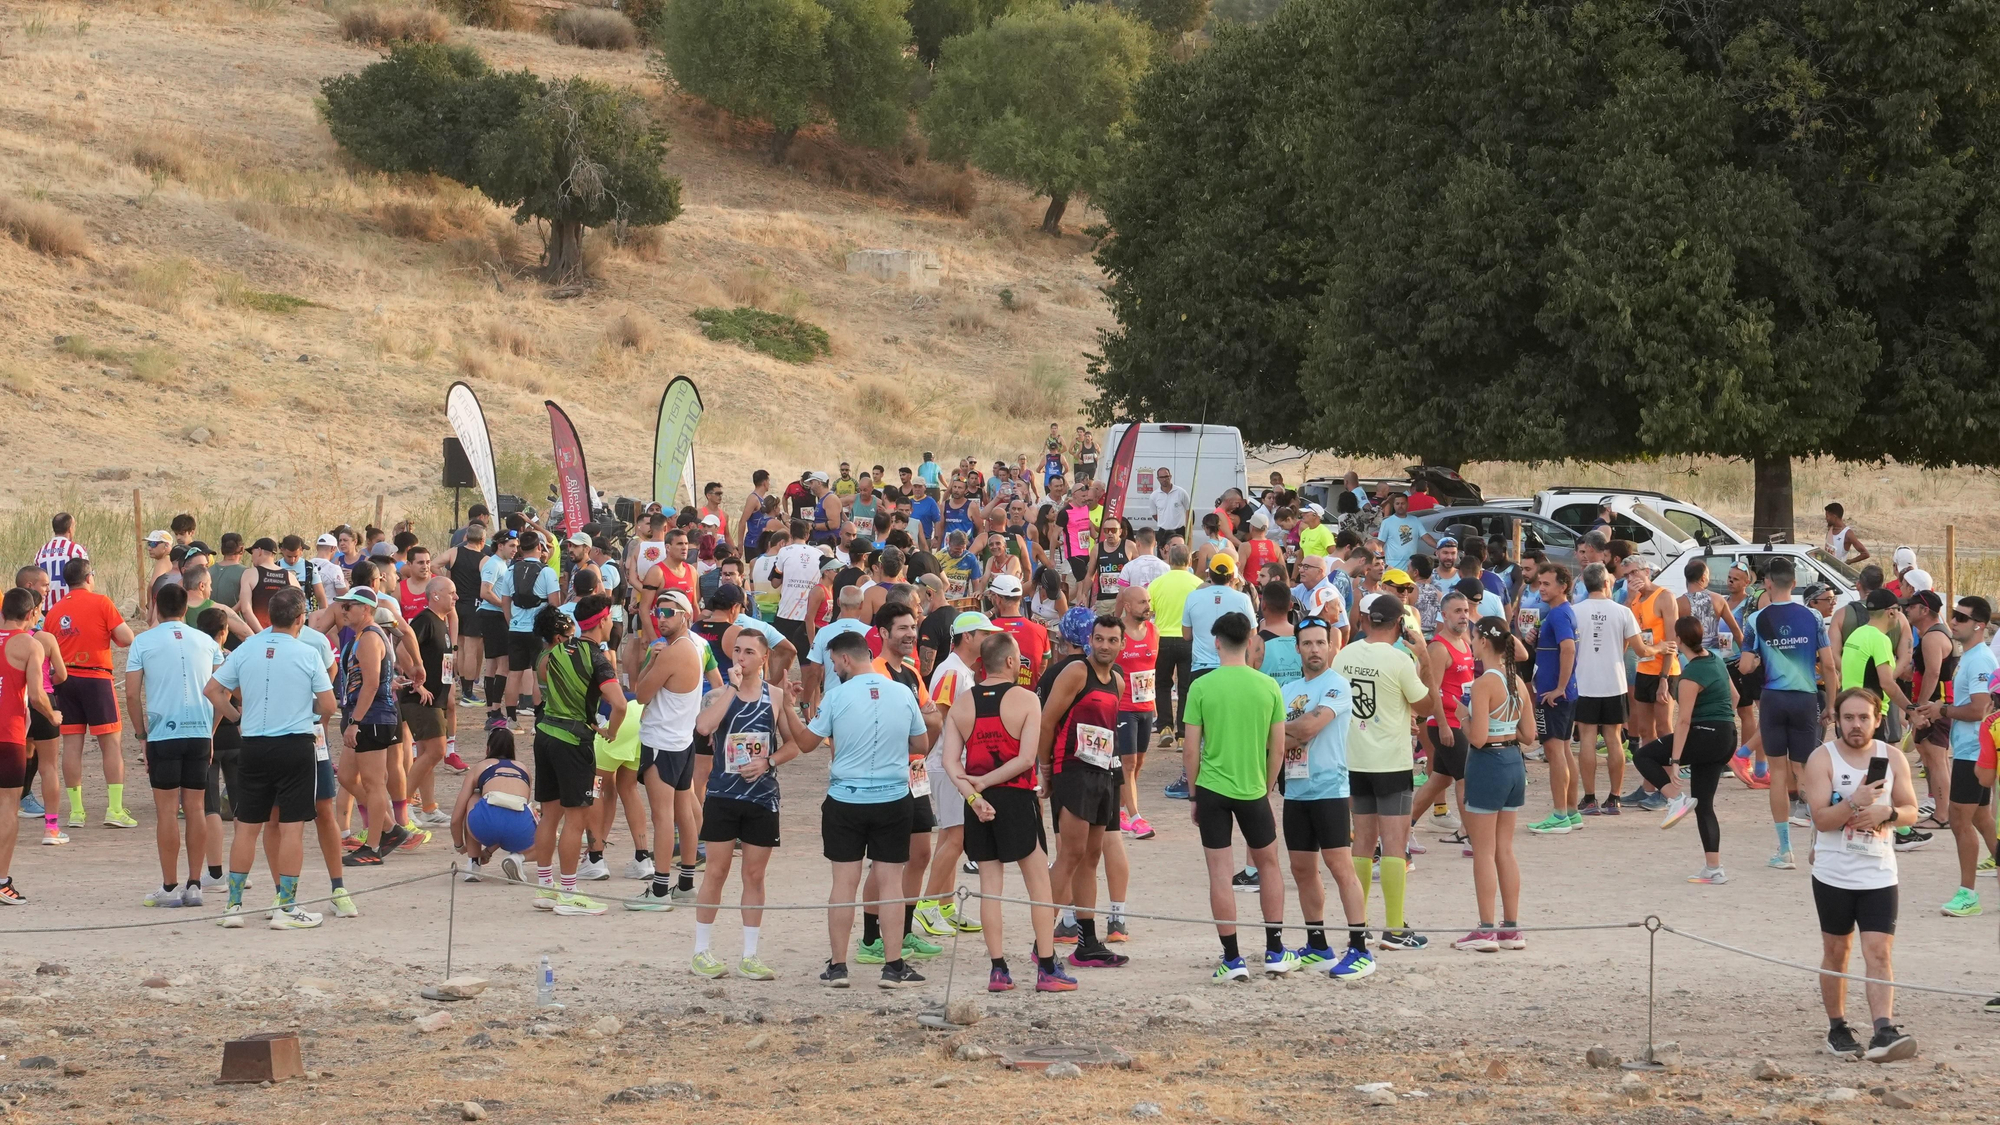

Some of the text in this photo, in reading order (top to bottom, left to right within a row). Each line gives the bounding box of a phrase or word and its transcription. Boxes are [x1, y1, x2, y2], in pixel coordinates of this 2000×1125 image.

[1521, 614, 1534, 623] 209
[1343, 665, 1380, 678] MI FUERZA
[1139, 678, 1153, 689] 178
[1086, 734, 1108, 749] 547
